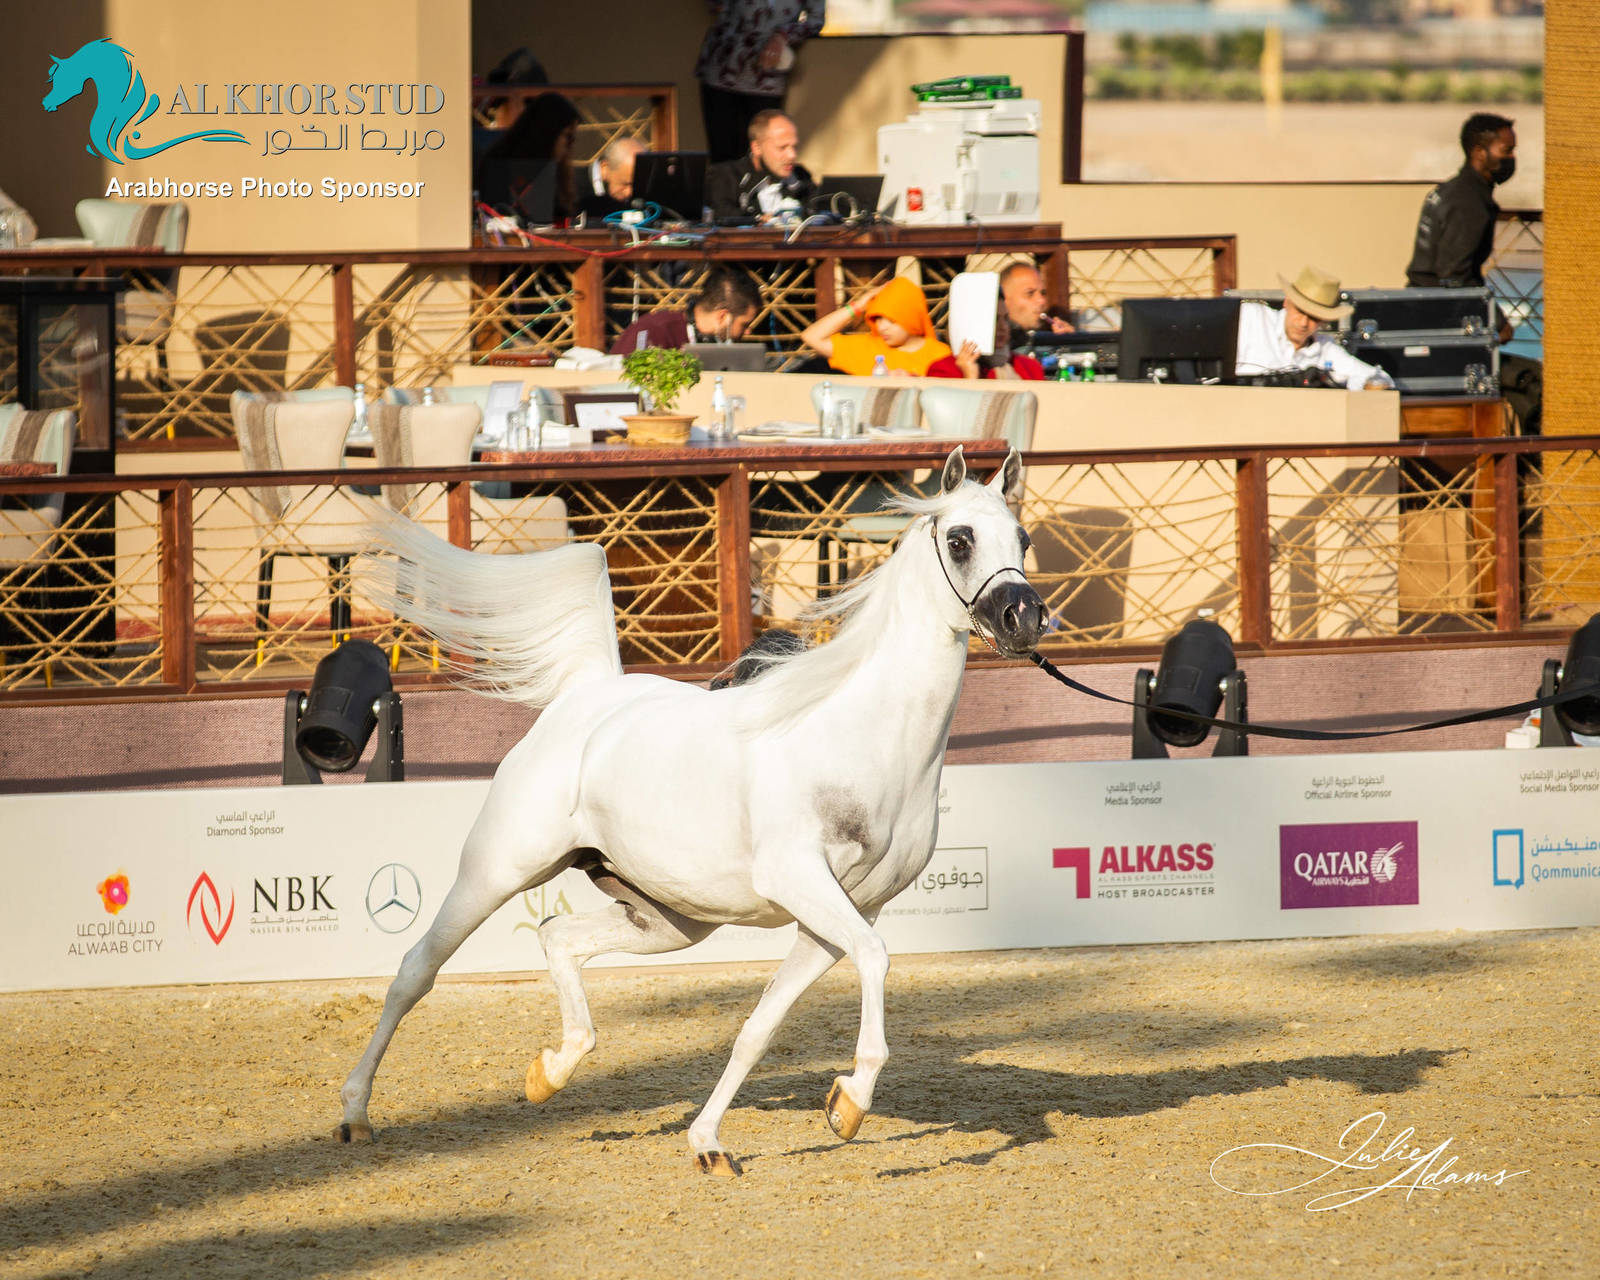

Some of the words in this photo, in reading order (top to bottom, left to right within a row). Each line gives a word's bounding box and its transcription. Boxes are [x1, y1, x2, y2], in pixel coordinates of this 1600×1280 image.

[1304, 789, 1333, 800] Official
[1334, 789, 1359, 799] Airline
[1360, 787, 1392, 800] Sponsor
[1519, 783, 1543, 793] Social
[1544, 783, 1567, 793] Media
[1569, 782, 1600, 793] Sponsor
[1104, 796, 1129, 806] Media
[1130, 795, 1163, 806] Sponsor
[215, 811, 248, 825] الماسي
[248, 810, 276, 823] الراعي
[206, 826, 247, 837] Diamond
[249, 825, 284, 837] Sponsor
[1098, 842, 1215, 874] ALKASS
[1293, 850, 1369, 882] QATAR
[250, 875, 337, 914] NBK
[1097, 889, 1128, 899] HOST
[1132, 886, 1215, 898] BROADCASTER
[132, 938, 164, 953] CITY
